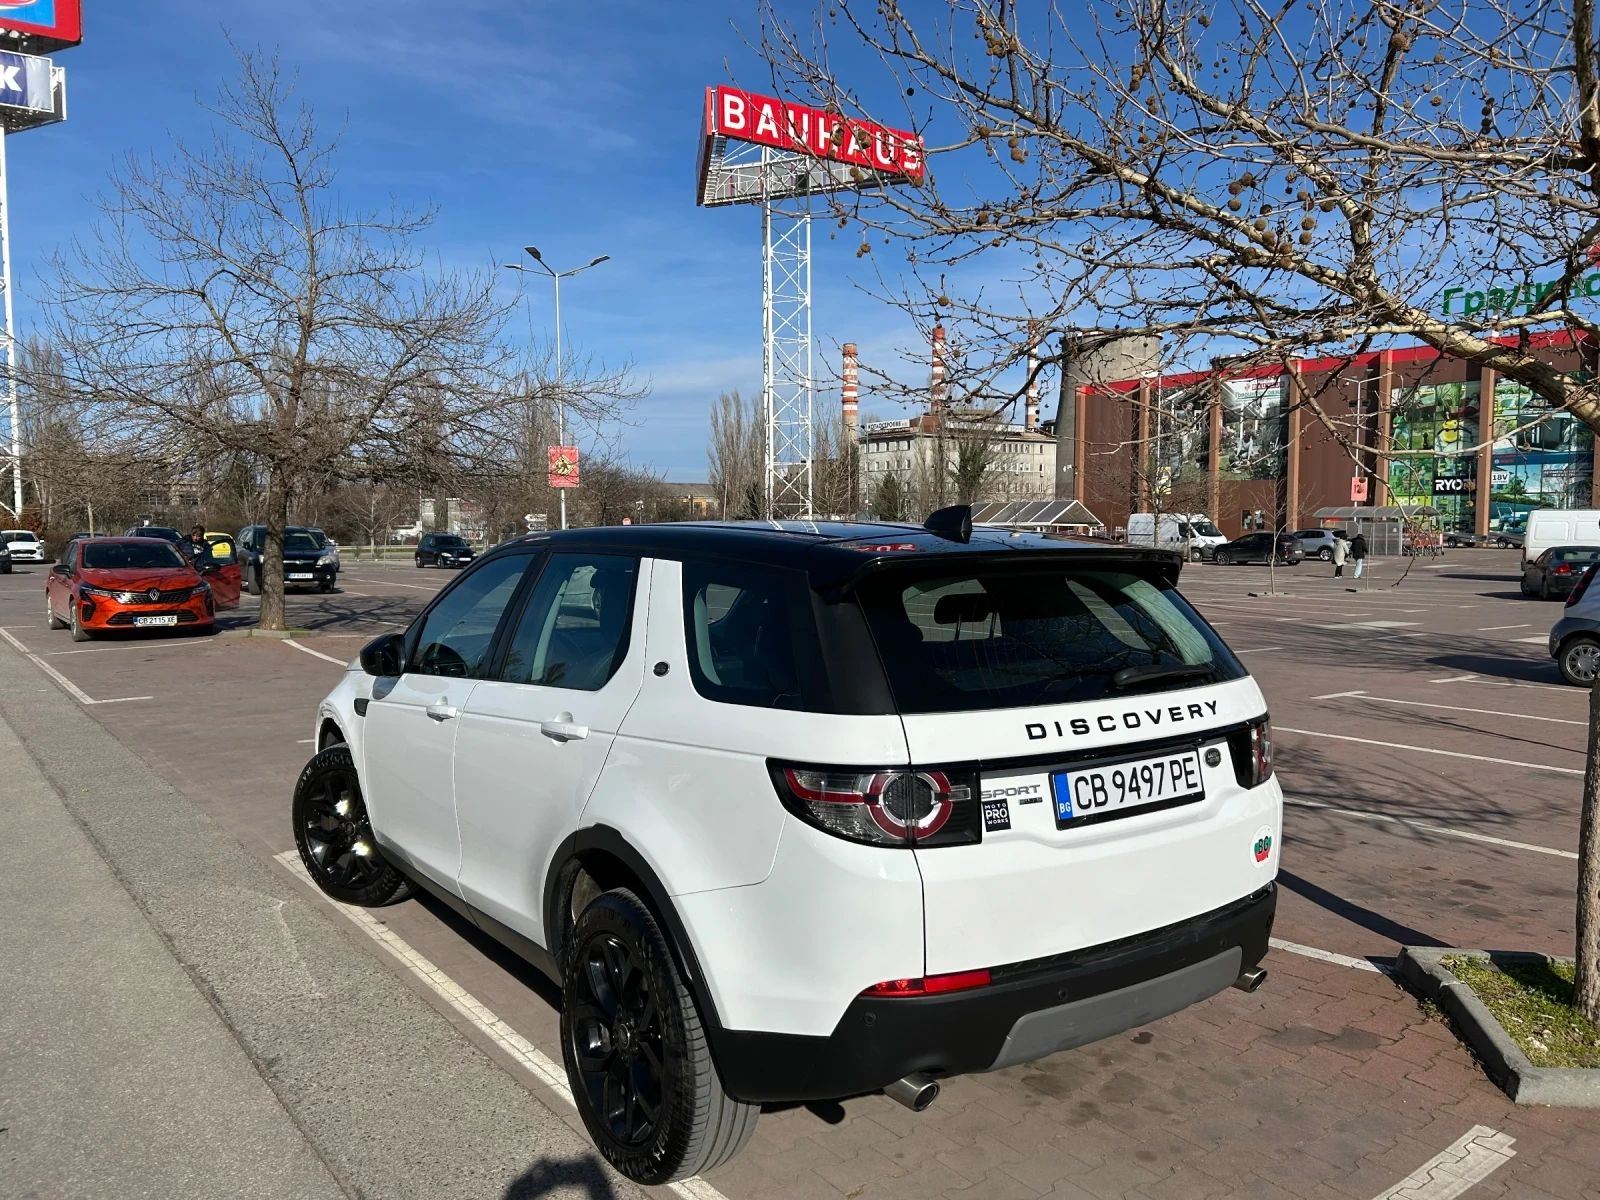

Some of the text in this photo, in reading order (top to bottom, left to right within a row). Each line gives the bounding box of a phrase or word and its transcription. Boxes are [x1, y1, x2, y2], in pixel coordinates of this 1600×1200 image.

[723, 93, 921, 170] BAUHAUS
[1434, 478, 1476, 491] RYO
[1025, 700, 1217, 740] DISCOVERY
[981, 784, 1041, 799] SPORT
[1074, 756, 1199, 810] CB 9497 PE
[985, 808, 1008, 820] PRO
[1059, 802, 1071, 813] BG
[1258, 835, 1269, 854] BG
